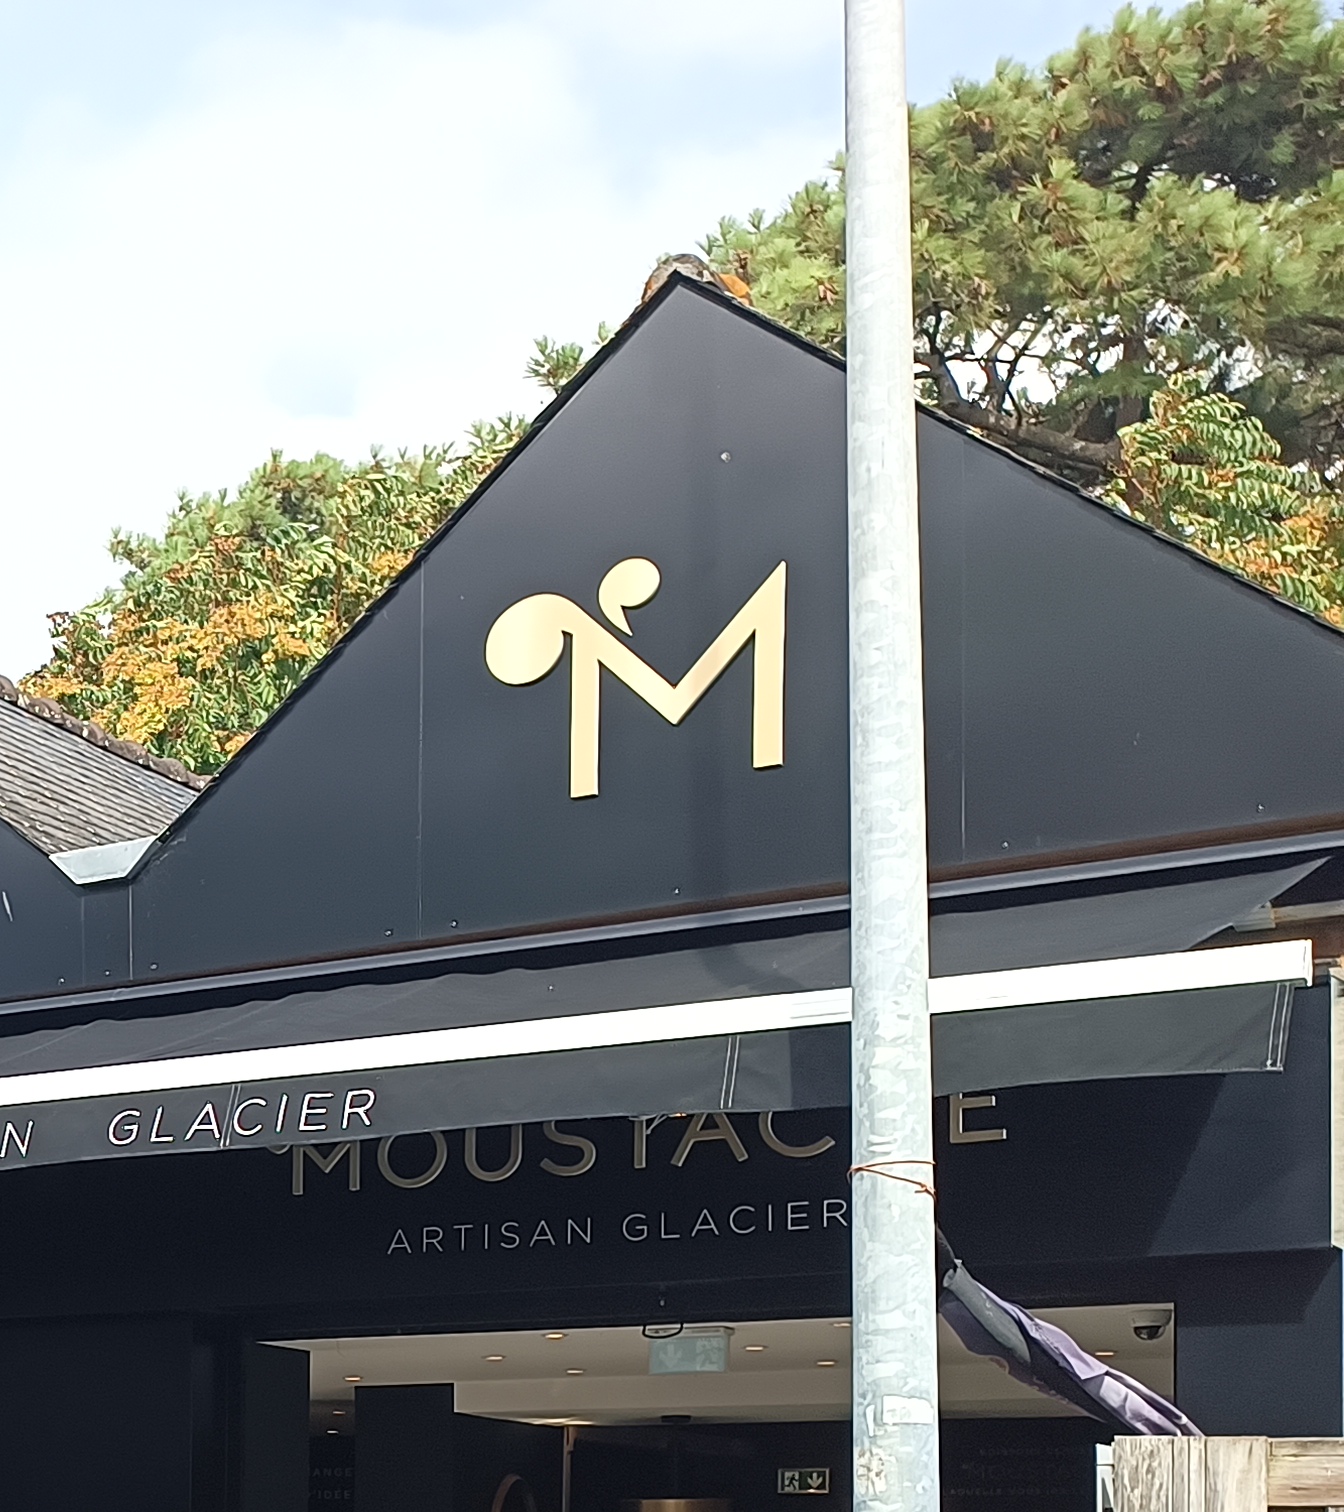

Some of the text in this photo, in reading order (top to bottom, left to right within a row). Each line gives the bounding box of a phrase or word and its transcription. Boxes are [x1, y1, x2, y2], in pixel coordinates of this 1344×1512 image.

[108, 1089, 378, 1146] GLACIER
[387, 1198, 849, 1255] ARTISAN GLACIER
